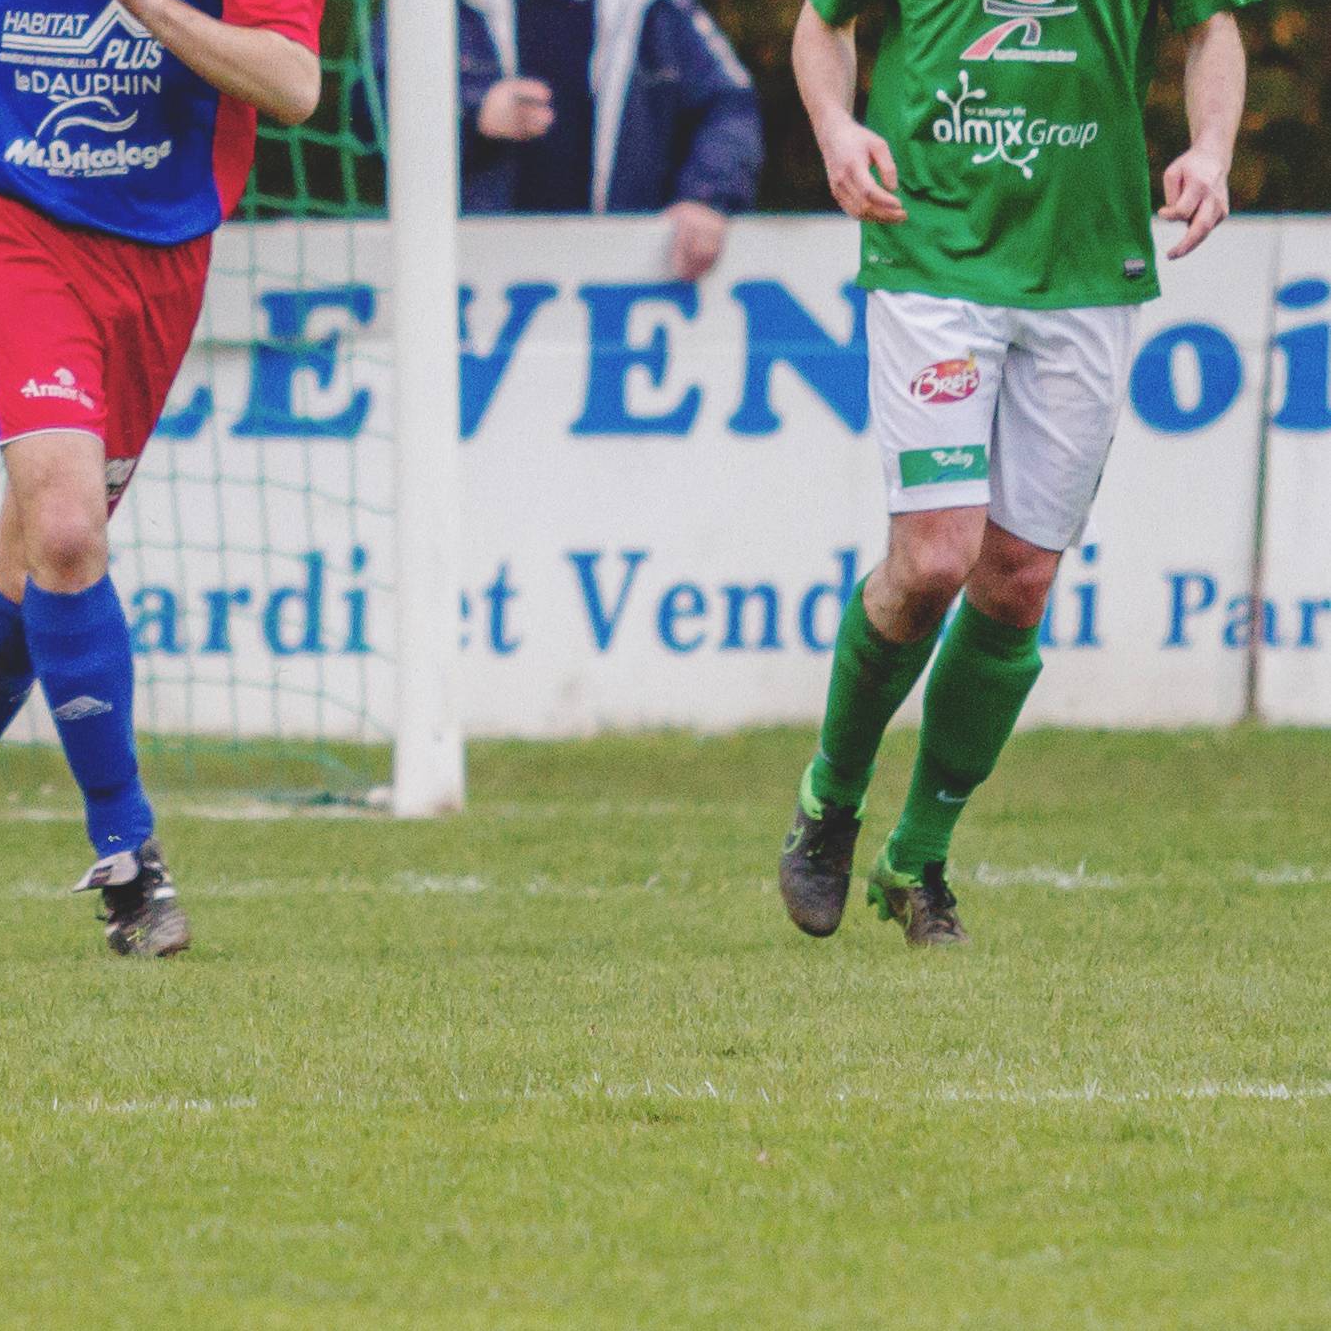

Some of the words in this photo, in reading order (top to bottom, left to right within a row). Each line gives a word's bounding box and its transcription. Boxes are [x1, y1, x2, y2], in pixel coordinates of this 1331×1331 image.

[3, 10, 90, 37] HABITAT
[101, 38, 165, 70] PLUS
[1027, 118, 1099, 149] Group
[111, 544, 374, 655] ardi
